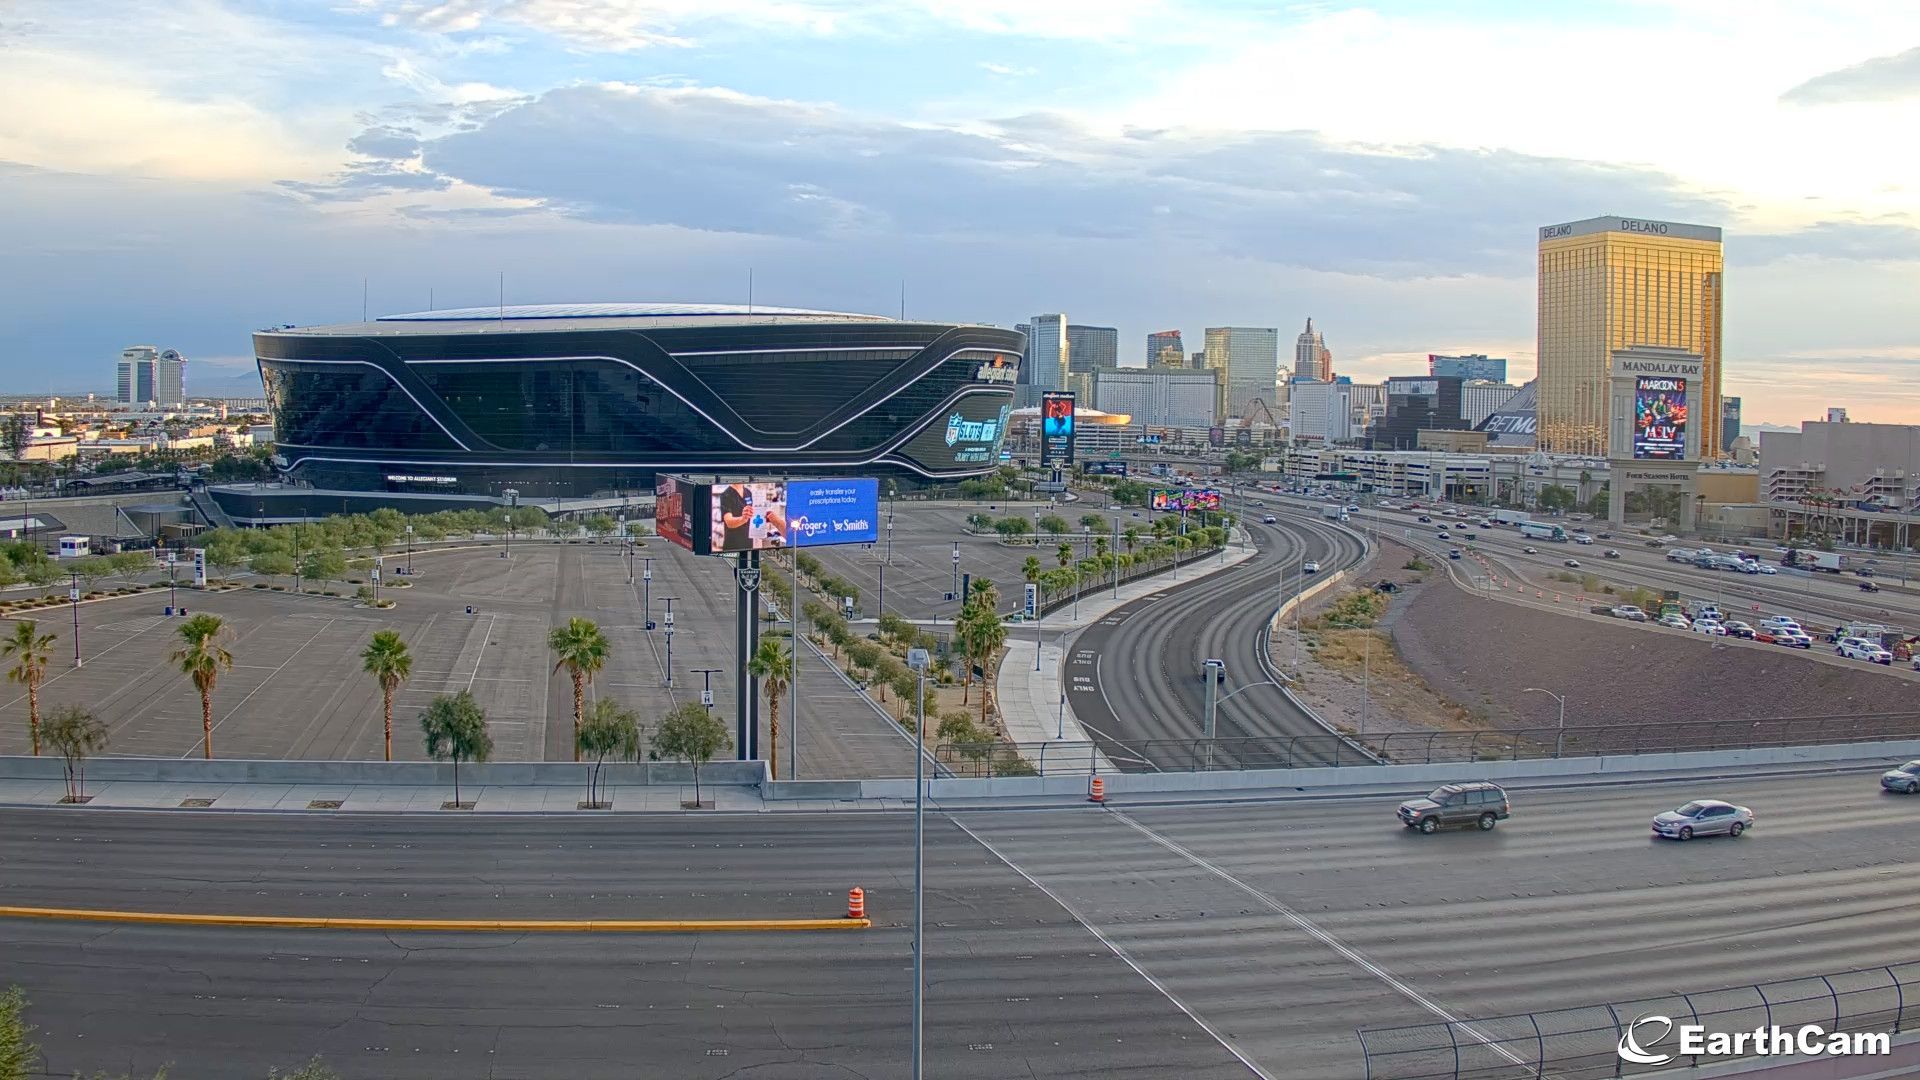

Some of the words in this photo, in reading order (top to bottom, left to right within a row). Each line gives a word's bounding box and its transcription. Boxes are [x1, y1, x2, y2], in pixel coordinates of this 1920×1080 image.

[1544, 225, 1572, 238] DELANO
[1622, 220, 1668, 234] DELANO
[1622, 362, 1679, 373] MANDALAY
[1682, 364, 1700, 374] BAY
[1639, 380, 1677, 391] MAROON
[1677, 381, 1685, 392] 5
[959, 424, 982, 440] SLOTS
[808, 497, 841, 505] prescriptions
[841, 496, 857, 504] today
[843, 519, 869, 531] Smith's
